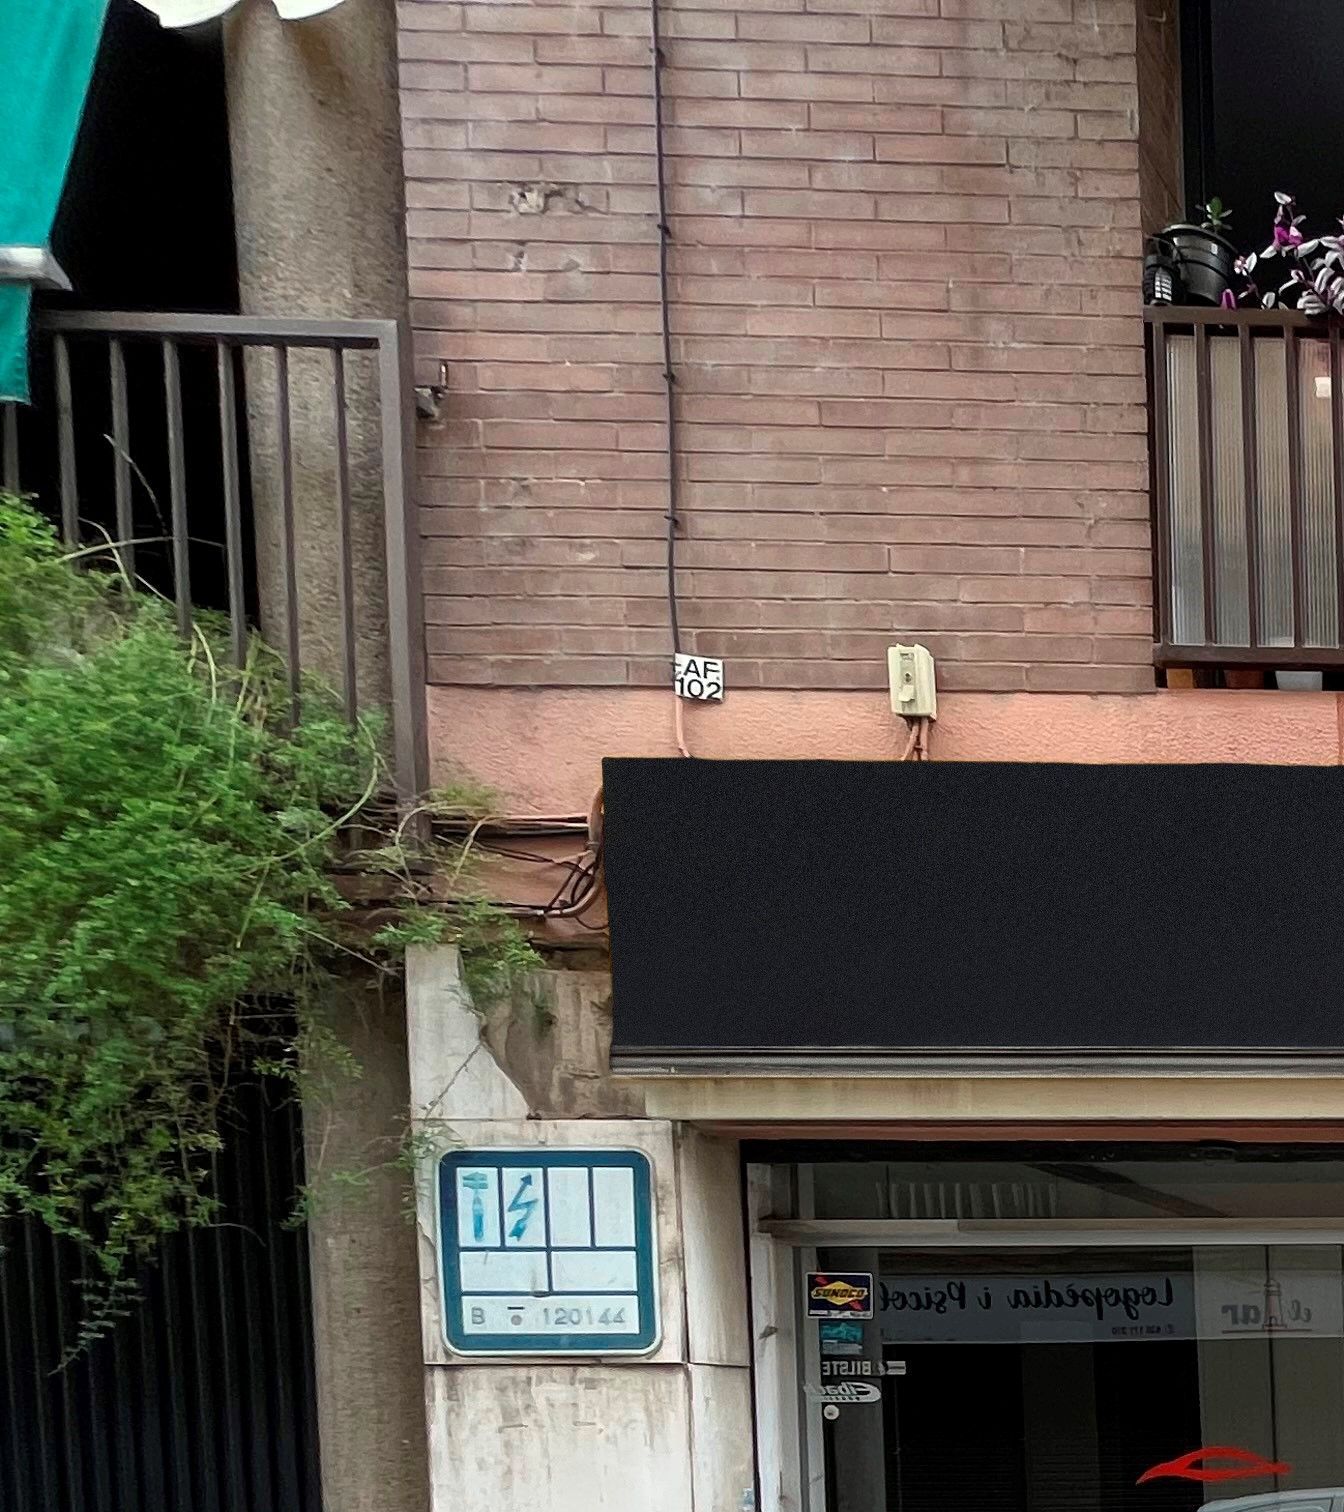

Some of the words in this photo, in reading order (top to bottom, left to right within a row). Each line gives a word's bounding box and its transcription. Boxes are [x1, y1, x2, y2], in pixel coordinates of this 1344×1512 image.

[675, 677, 721, 700] 102
[471, 1306, 486, 1325] B
[543, 1306, 626, 1326] 120144
